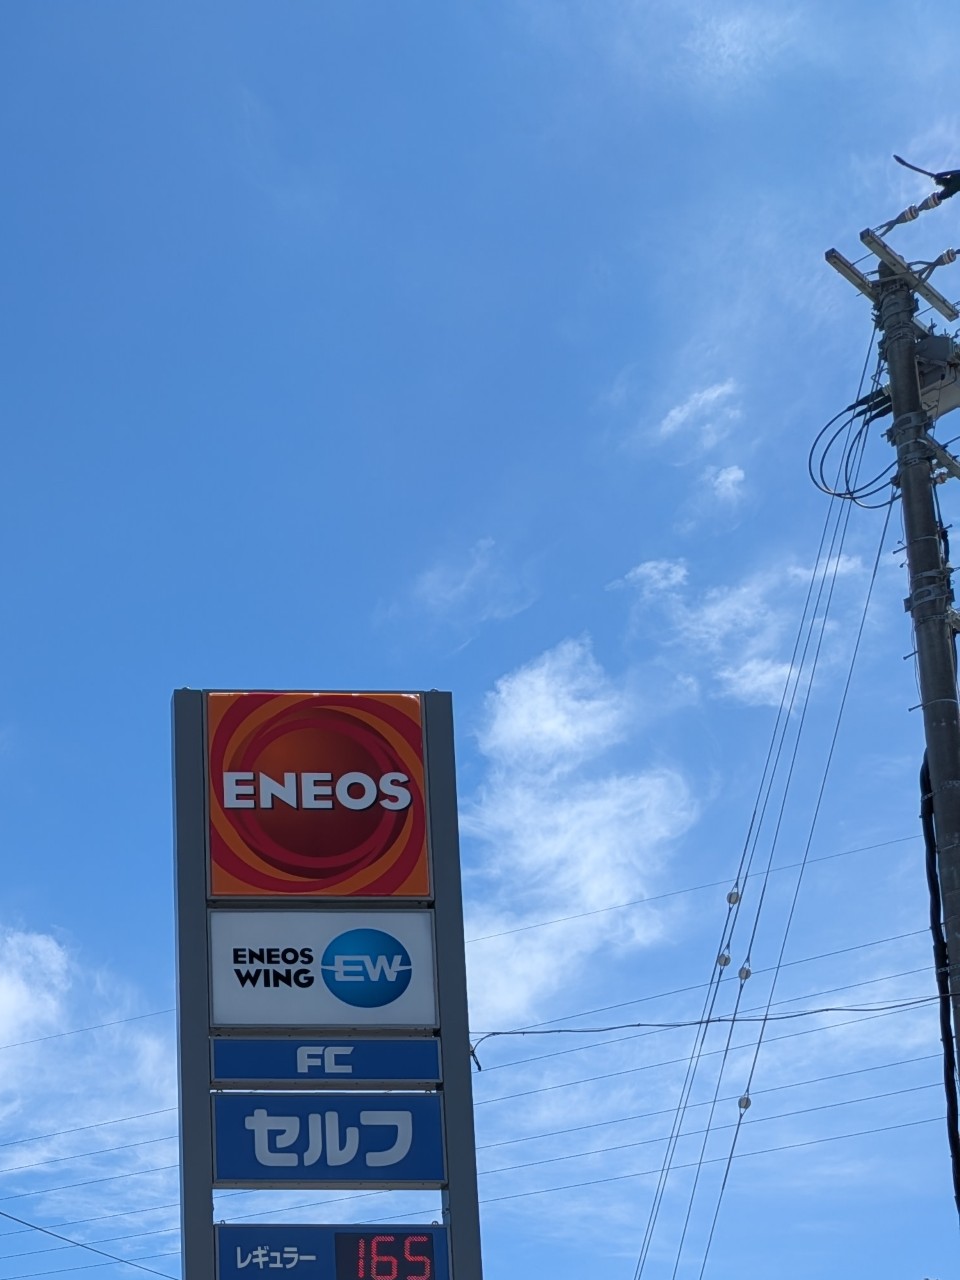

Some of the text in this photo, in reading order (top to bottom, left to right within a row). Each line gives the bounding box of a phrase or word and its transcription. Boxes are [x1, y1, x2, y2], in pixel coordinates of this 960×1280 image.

[222, 771, 412, 810] ENEOS
[233, 947, 314, 965] ENEOS
[334, 954, 403, 982] EW
[234, 968, 315, 988] WING
[296, 1046, 355, 1073] FC
[245, 1108, 413, 1167] セルフ
[236, 1246, 317, 1269] レギュラー
